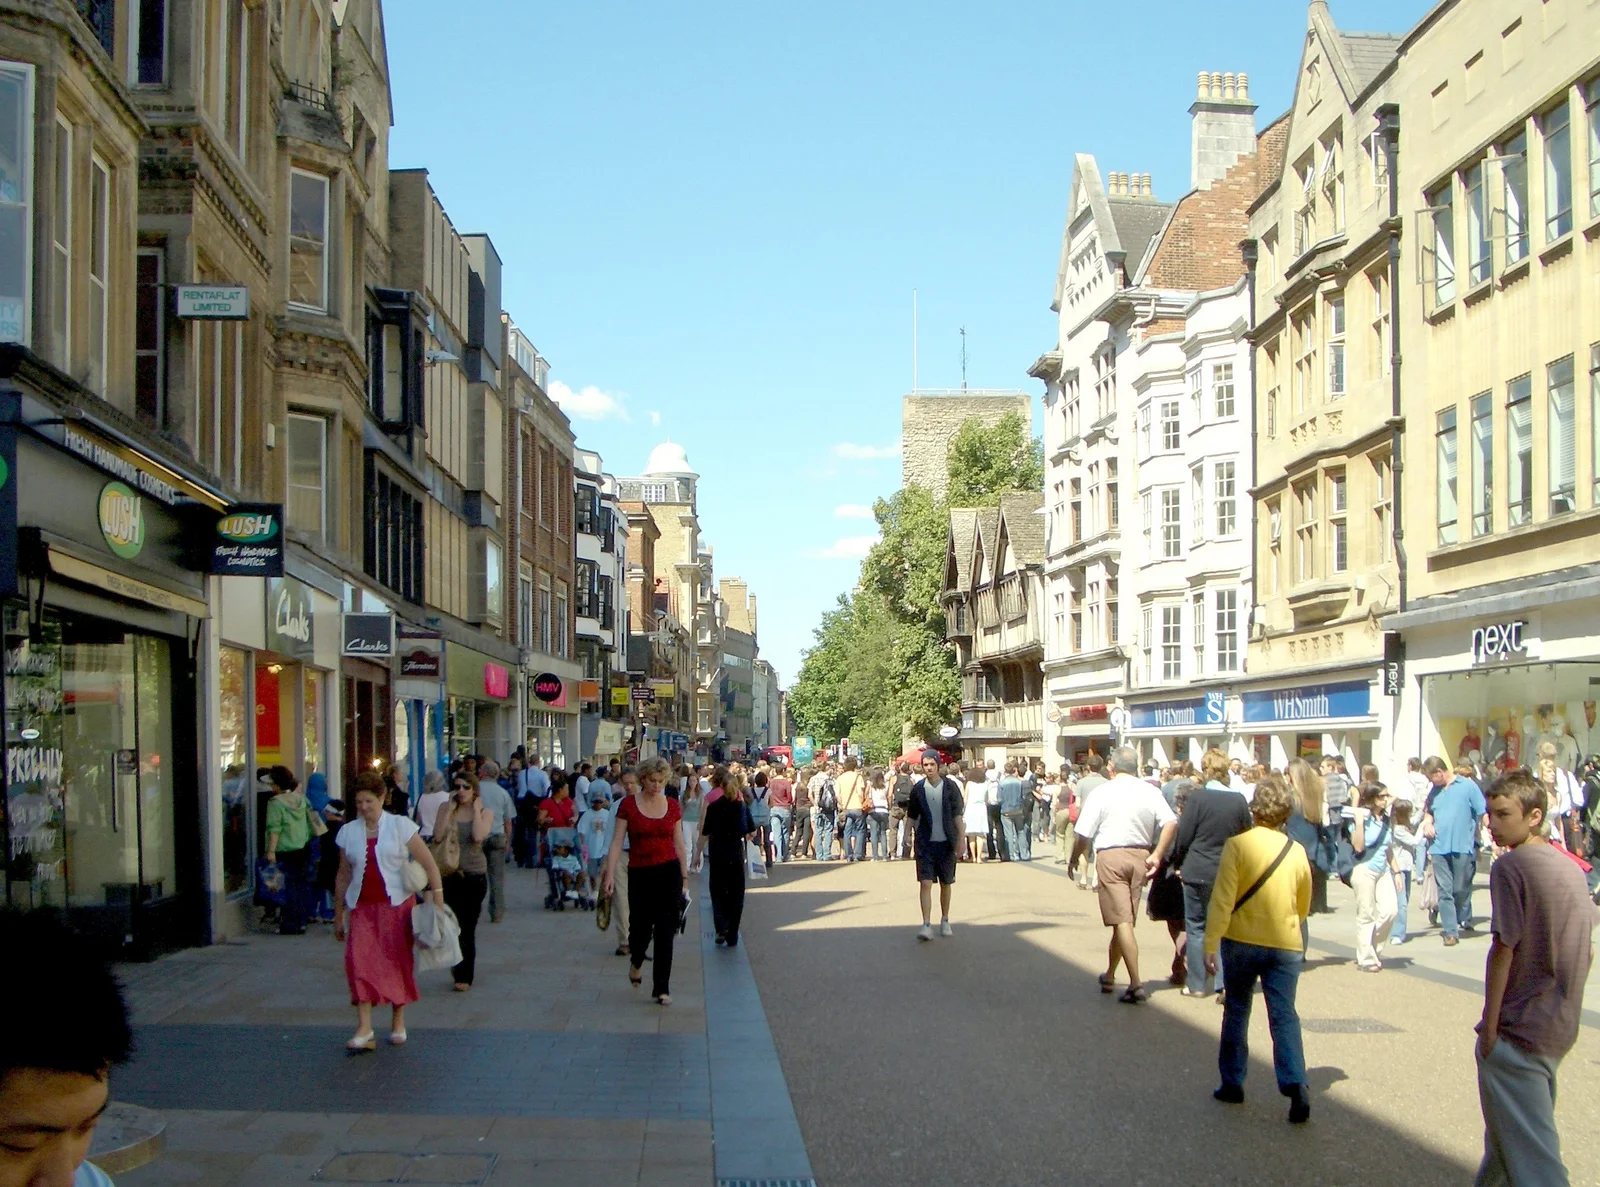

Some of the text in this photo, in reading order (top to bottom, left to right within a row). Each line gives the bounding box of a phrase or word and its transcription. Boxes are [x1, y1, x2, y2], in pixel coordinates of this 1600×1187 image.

[183, 290, 241, 300] RENTAFLAT
[192, 302, 232, 312] LIMITED
[139, 470, 175, 506] COSMETICS
[104, 495, 141, 545] LUSH
[222, 514, 273, 536] LUSH
[276, 588, 310, 643] Clarks
[346, 638, 389, 652] Clarks
[1472, 622, 1523, 657] next
[535, 682, 560, 693] HMV
[1387, 661, 1399, 695] next
[1208, 692, 1223, 700] WH
[1273, 692, 1330, 720] WHSmith
[1154, 705, 1196, 727] WHSmith
[1206, 700, 1224, 723] S
